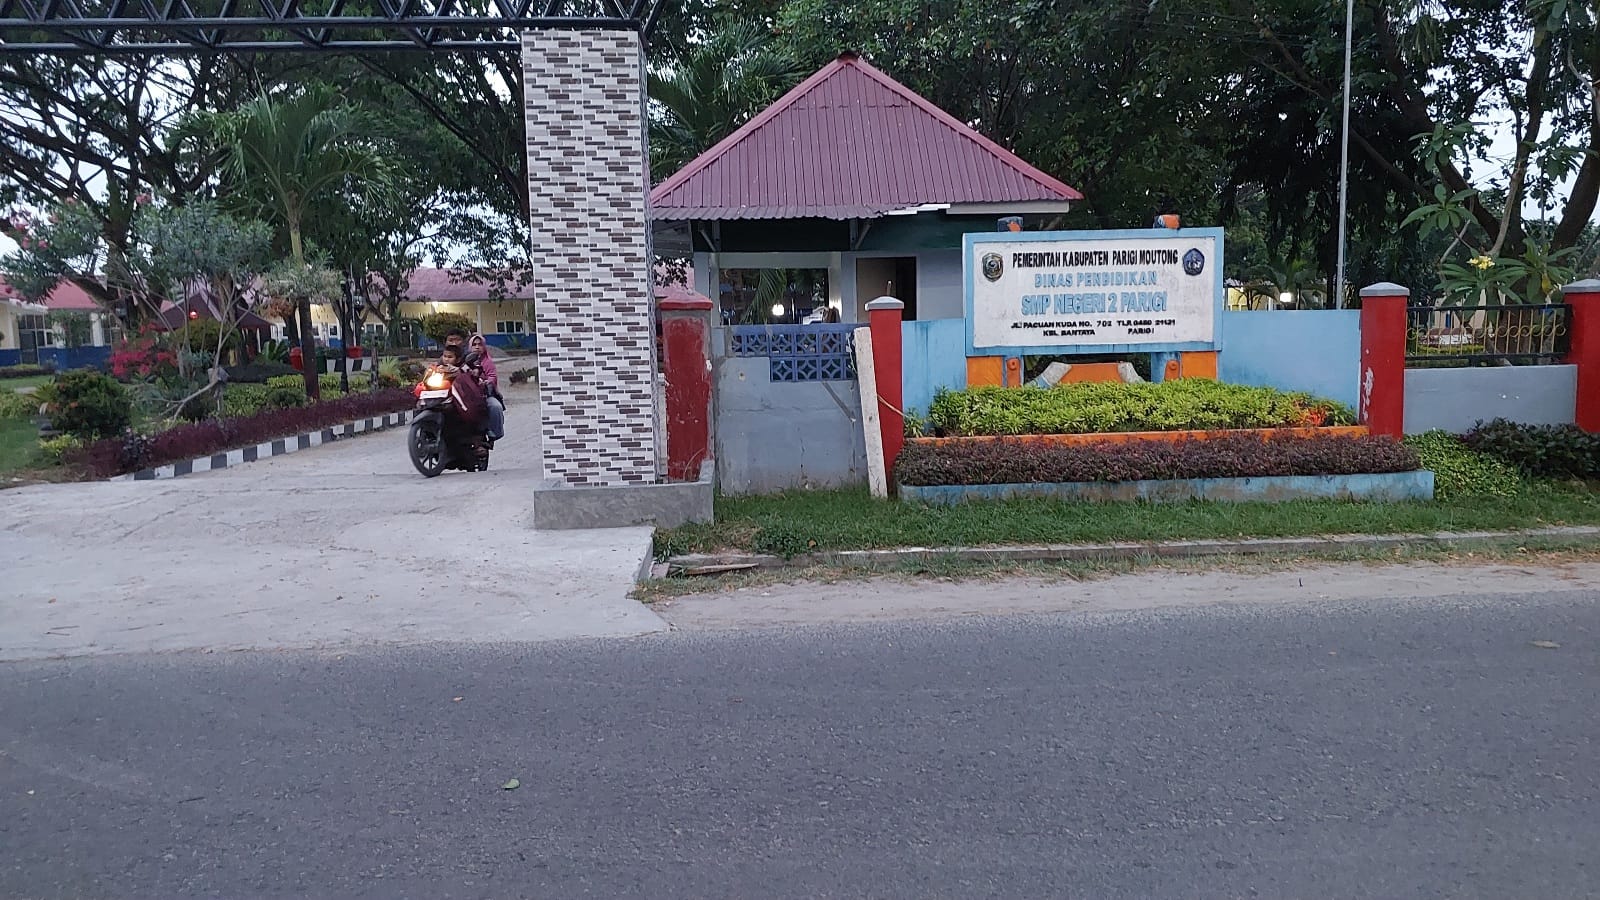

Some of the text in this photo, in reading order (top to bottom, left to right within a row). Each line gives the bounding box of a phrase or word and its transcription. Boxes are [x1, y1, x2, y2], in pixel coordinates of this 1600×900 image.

[1012, 249, 1178, 268] PEMERINTAH KABUPATEN PARIGI MOUTONG
[1034, 271, 1157, 288] DINAS PENDIDIKAN
[1021, 291, 1168, 315] SMP NEGERI 2 PARIGI
[1023, 321, 1055, 329] PACUAN
[1055, 320, 1077, 328] KUDA
[1060, 328, 1096, 337] BANTATA
[1127, 327, 1154, 336] PARIGI
